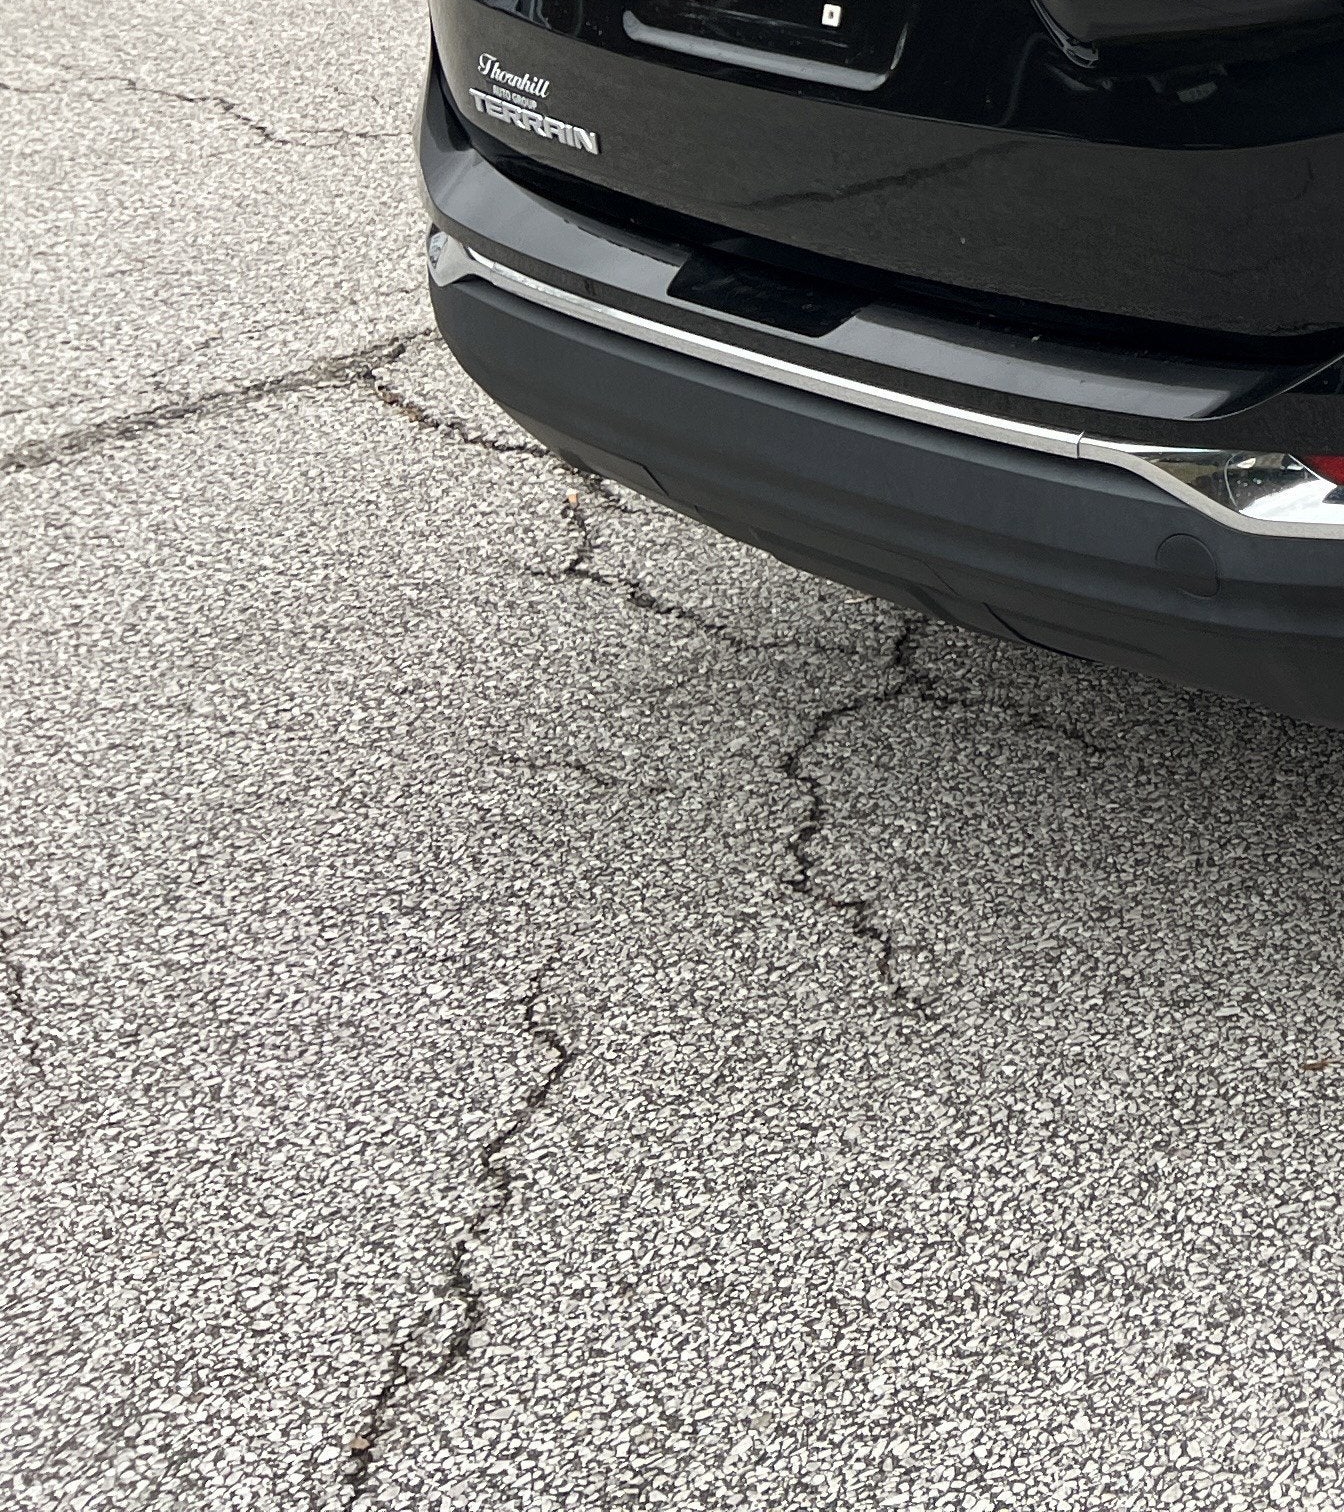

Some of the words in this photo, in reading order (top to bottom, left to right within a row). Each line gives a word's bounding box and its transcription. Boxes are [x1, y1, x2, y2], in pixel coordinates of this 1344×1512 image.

[477, 52, 550, 98] Thornhill
[492, 84, 512, 102] AUTO
[511, 92, 538, 110] GROUP
[468, 87, 599, 155] TERRAIN
